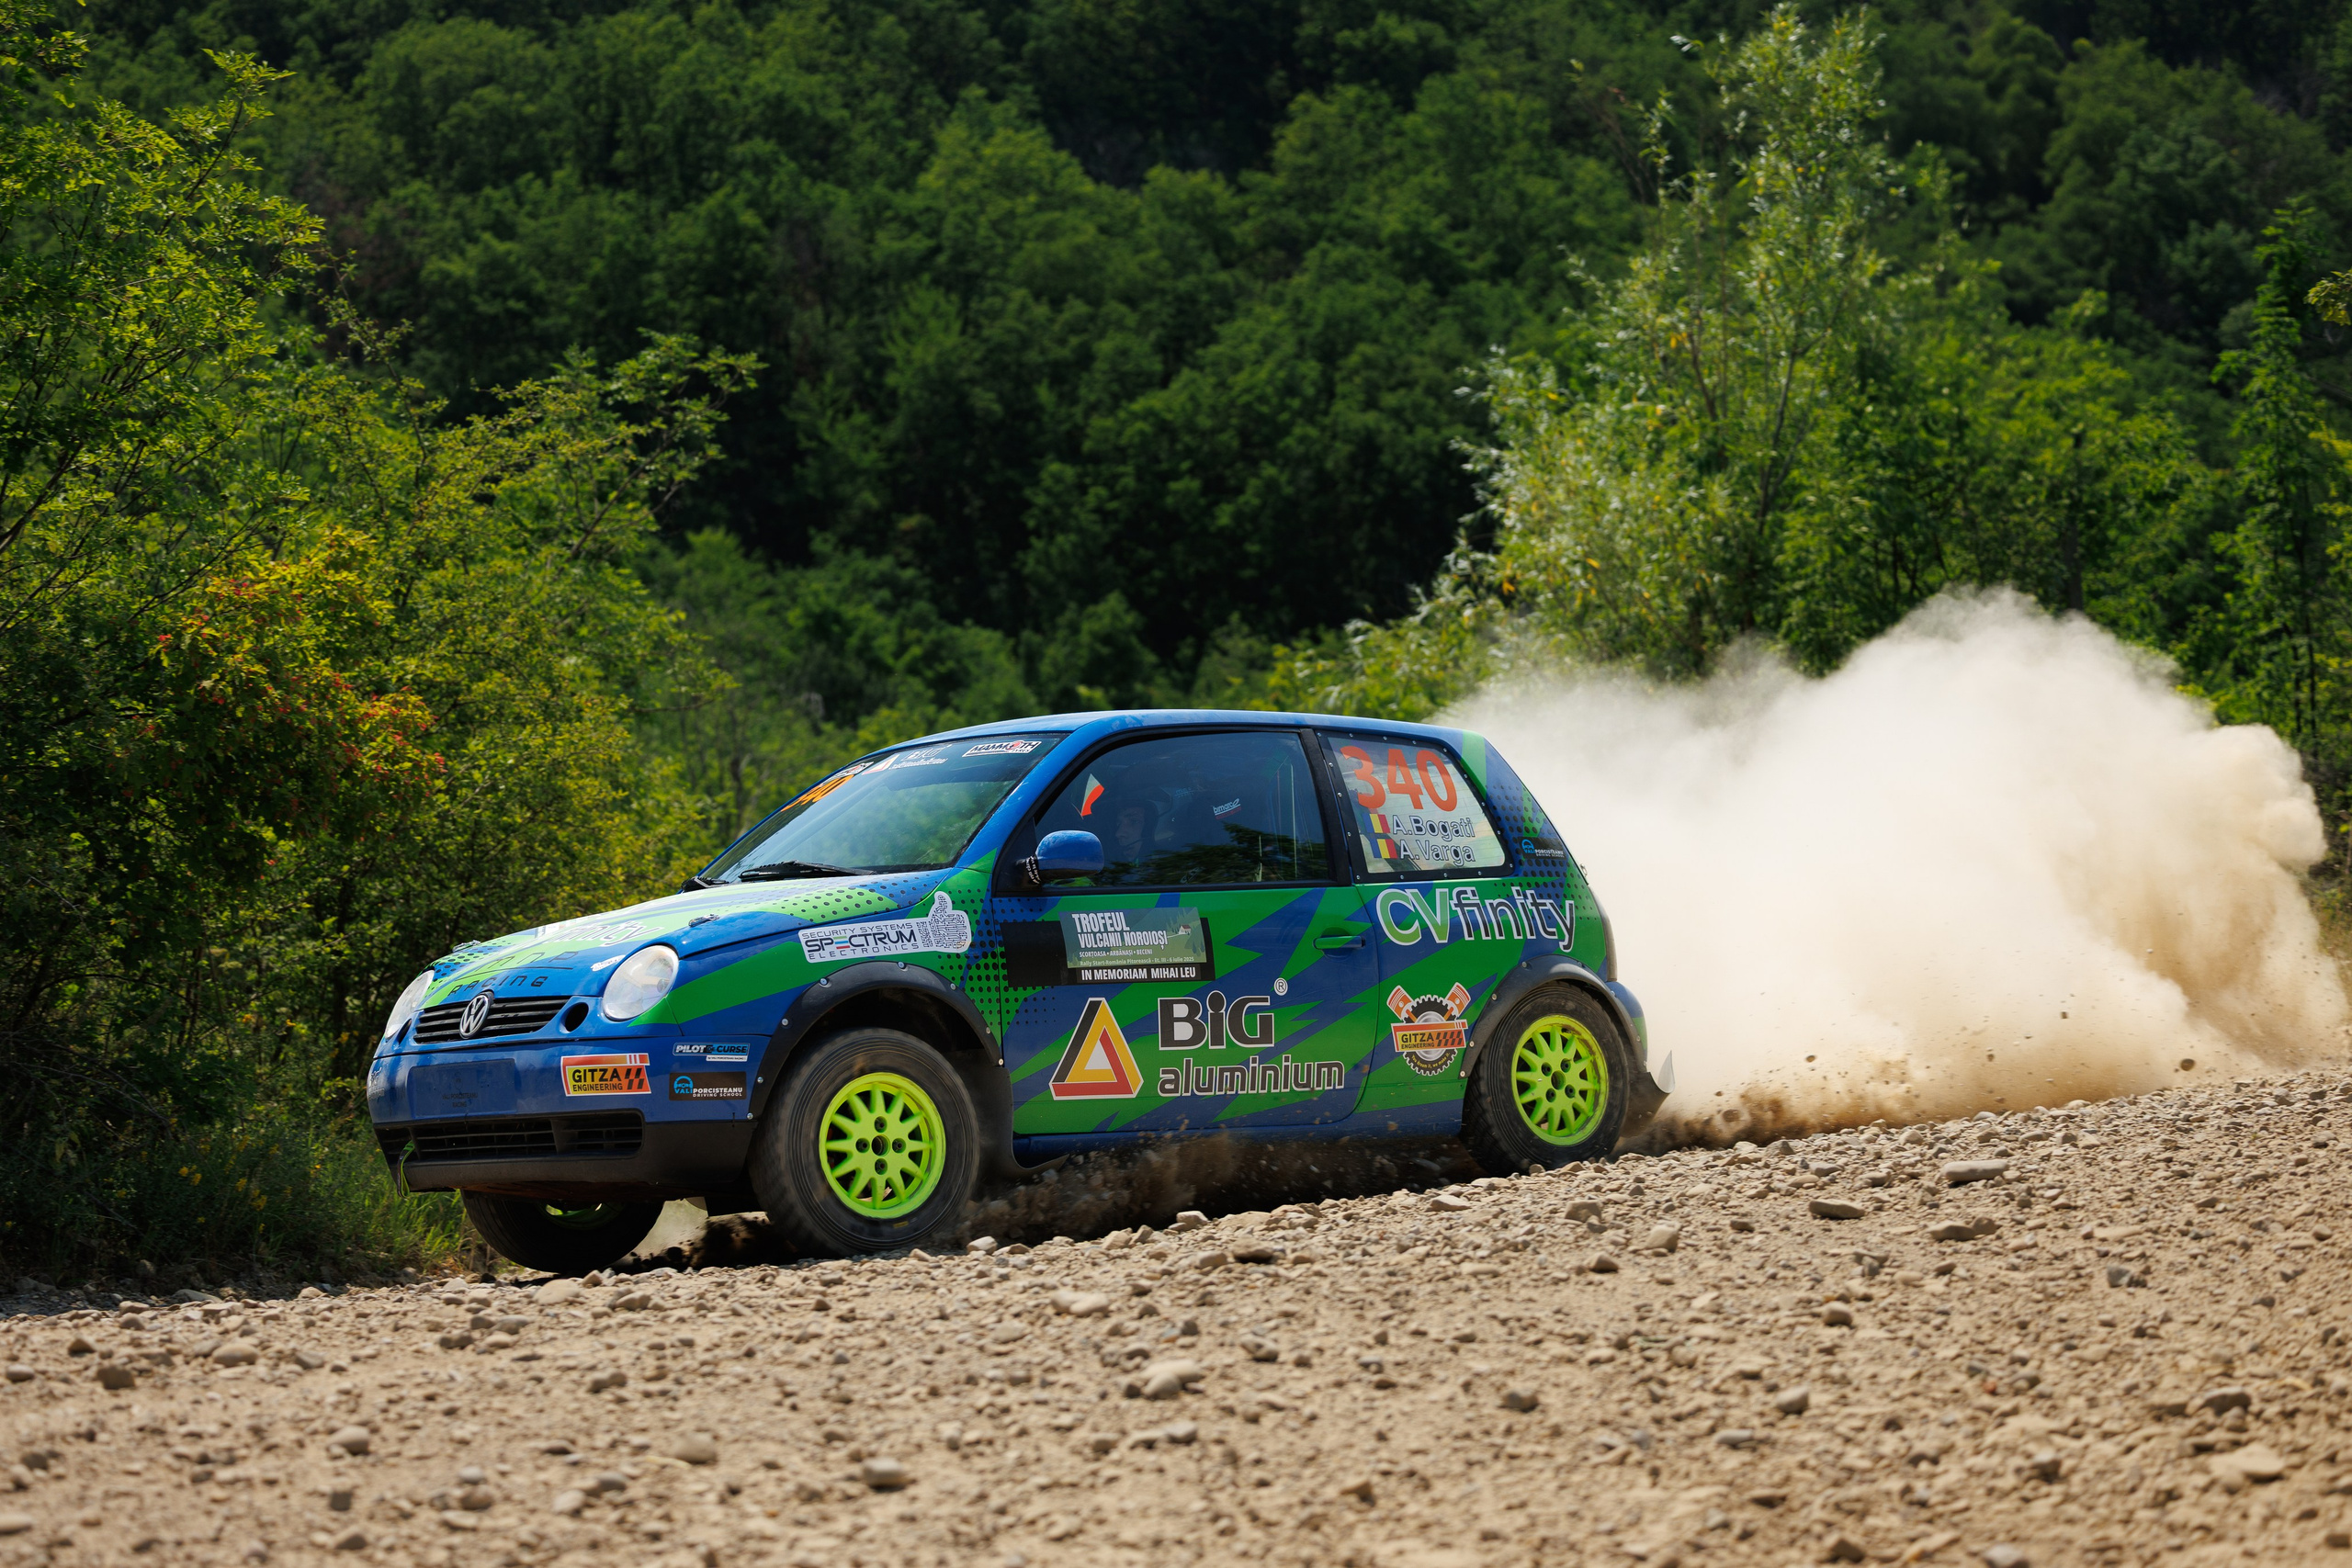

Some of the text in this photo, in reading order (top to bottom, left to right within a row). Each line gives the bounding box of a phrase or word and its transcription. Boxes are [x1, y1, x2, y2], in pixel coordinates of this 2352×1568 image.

[1340, 745, 1458, 812] 340
[1393, 815, 1476, 842] A.Bogati
[1400, 840, 1476, 866] A.Varga
[1071, 912, 1130, 932] TROFEUL
[1376, 886, 1576, 953] CVfinity
[802, 922, 912, 940] SECURITY SYSTEMS
[1078, 931, 1168, 950] VULCANII NOROIOȘI
[805, 930, 917, 953] SPECTRUM
[808, 943, 919, 960] ELECTRONICS
[1081, 966, 1196, 981] IN MEMORIAM MIHAI LEU
[447, 976, 548, 997] RACING
[1401, 1032, 1434, 1043] GITZA
[675, 1044, 706, 1053] PILOT
[717, 1044, 747, 1054] CURSE
[571, 1067, 622, 1083] GITZA
[1158, 1055, 1345, 1097] aluminium
[572, 1083, 623, 1091] ENGINEERING
